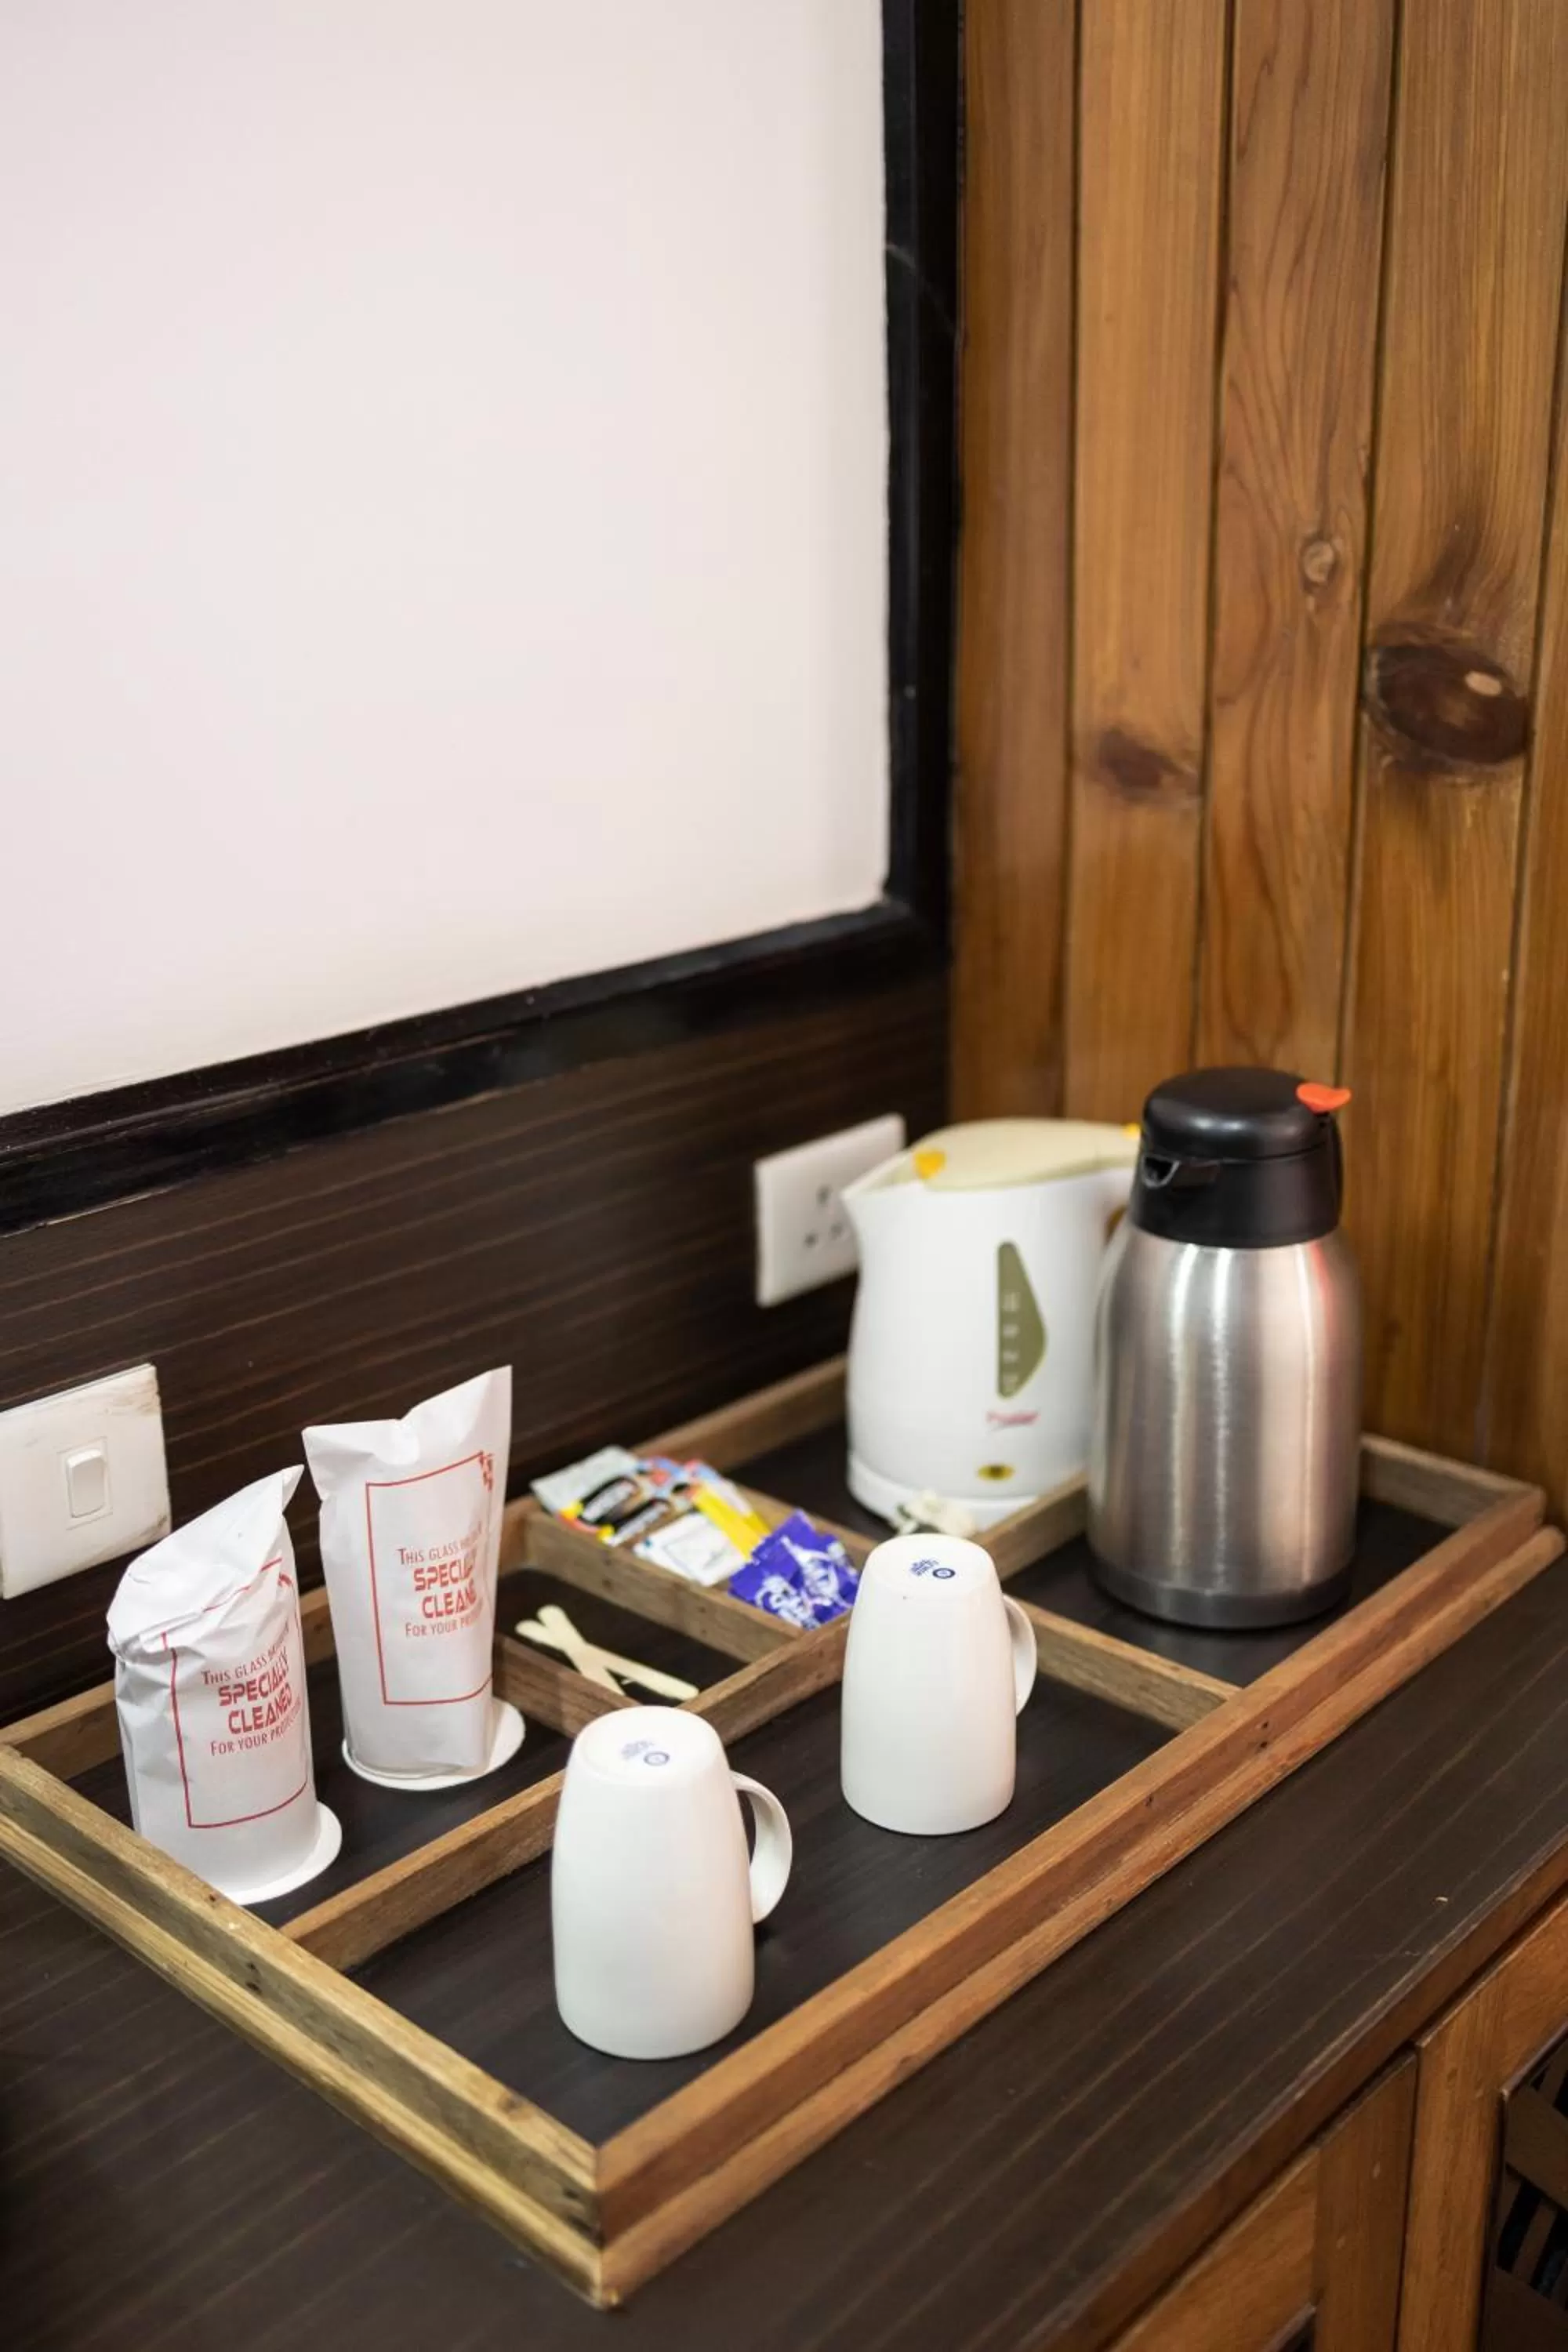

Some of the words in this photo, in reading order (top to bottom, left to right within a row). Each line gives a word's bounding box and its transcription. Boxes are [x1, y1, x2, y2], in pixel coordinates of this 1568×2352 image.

[397, 1548, 424, 1565] THIS
[429, 1541, 459, 1560] GLASS
[405, 1622, 427, 1637] FOR
[431, 1620, 458, 1635] YOUR
[201, 1669, 230, 1685] THIS
[235, 1656, 267, 1679] GLASS
[211, 1740, 234, 1756] FOR
[238, 1733, 267, 1752] YOUR
